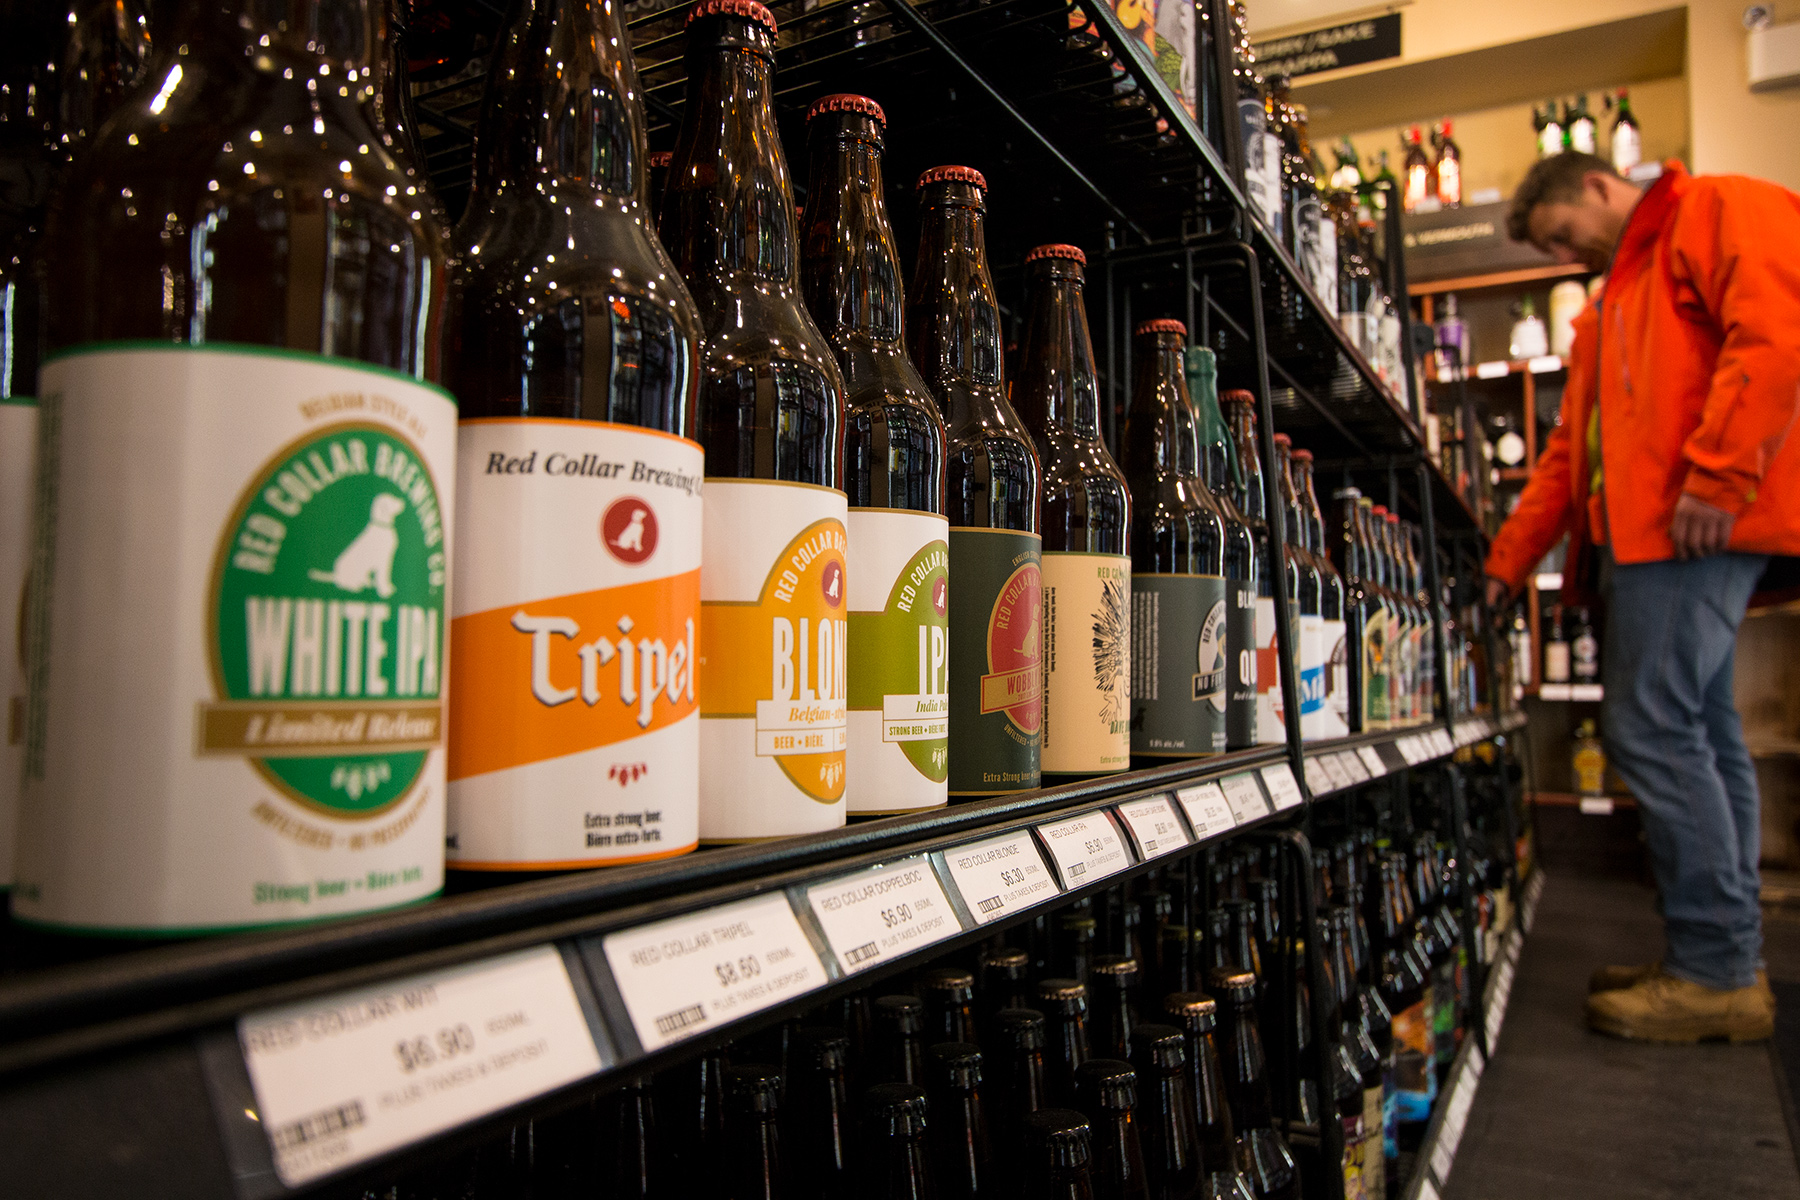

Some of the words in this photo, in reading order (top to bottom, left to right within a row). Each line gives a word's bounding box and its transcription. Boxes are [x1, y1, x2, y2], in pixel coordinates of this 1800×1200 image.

[485, 451, 538, 476] Red
[544, 451, 626, 481] Collar
[631, 460, 695, 498] Brewing
[233, 513, 287, 574] RED
[264, 438, 370, 517] COLLAR
[374, 442, 443, 548] BREWING
[774, 569, 799, 604] RED
[791, 530, 833, 572] COLLAR
[897, 584, 917, 613] RED
[910, 550, 941, 587] COLLAR
[1097, 566, 1110, 579] RED
[996, 605, 1012, 630] RED
[1005, 572, 1032, 606] COLLAR
[245, 597, 390, 697] WHITE
[395, 603, 439, 697] IPA
[510, 608, 695, 730] Tripel
[916, 700, 938, 713] India
[244, 711, 367, 743] Limited
[889, 726, 910, 736] STRONG
[911, 725, 923, 735] BEER
[774, 735, 795, 749] BEER
[983, 772, 1001, 783] Extra
[1002, 771, 1020, 783] Strong
[583, 810, 611, 828] Extra
[614, 811, 642, 827] strong
[1049, 830, 1061, 840] RED
[1060, 825, 1080, 838] COLLAR
[1078, 822, 1089, 832] IPA
[585, 830, 611, 848] Bière
[1084, 838, 1105, 856] $6.90
[957, 857, 973, 870] RED
[971, 851, 996, 867] COLLAR
[994, 843, 1020, 860] BLONDE
[820, 895, 843, 912] RED
[841, 886, 875, 905] COLLAR
[874, 869, 922, 895] DOPPELBOC
[1000, 867, 1025, 888] $6.30
[1003, 892, 1017, 903] PLUS
[1015, 886, 1030, 899] TAXES
[1033, 879, 1050, 892] DEPOSIT
[252, 881, 311, 906] Strong
[880, 902, 913, 929] $6.90
[629, 945, 662, 969] RED
[662, 930, 715, 960] COLLAR
[713, 919, 754, 946] TRIPEL
[881, 937, 899, 949] PLUS
[899, 926, 918, 941] TAXES
[921, 915, 946, 933] DEPOSIT
[714, 953, 762, 988] $8.60
[736, 984, 766, 1004] TAXES
[772, 966, 812, 991] DEPOSIT
[302, 999, 399, 1046] COLLAR
